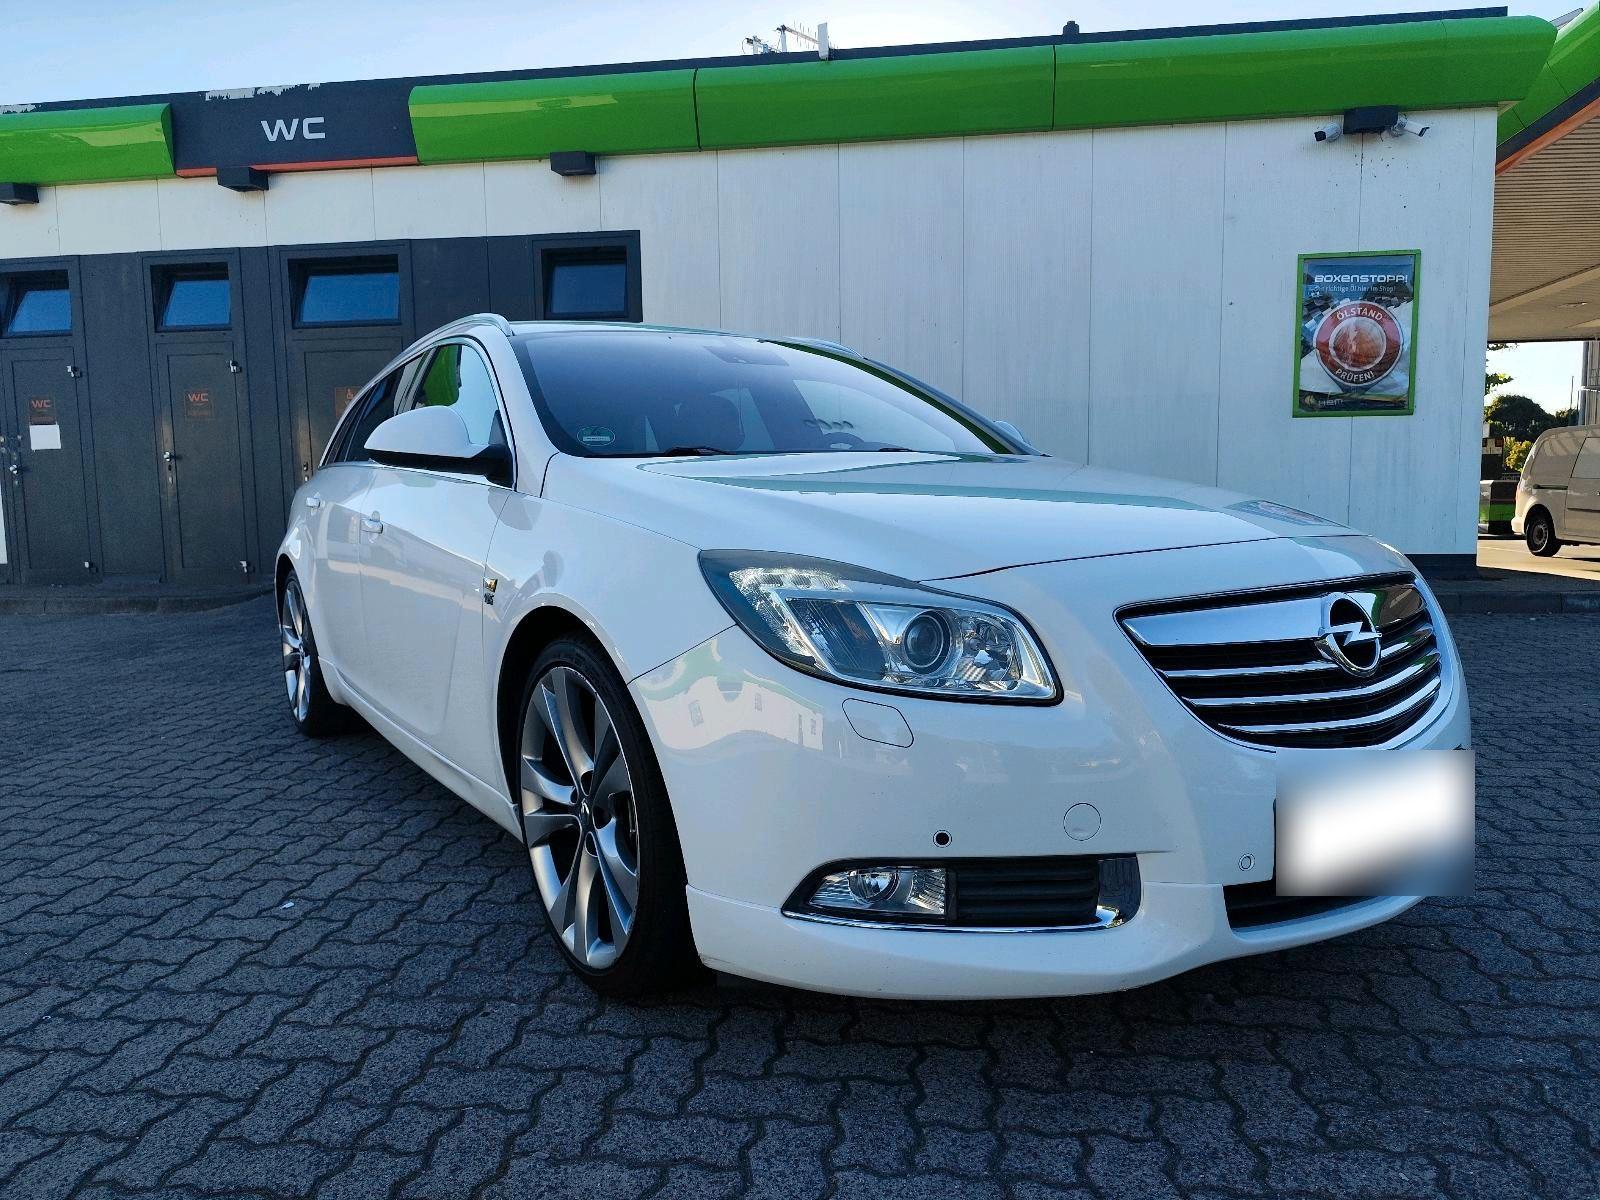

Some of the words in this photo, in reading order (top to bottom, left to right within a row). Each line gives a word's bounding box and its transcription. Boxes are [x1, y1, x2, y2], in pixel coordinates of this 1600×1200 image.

[261, 116, 326, 141] WC
[1336, 307, 1383, 321] ÖLSTAND
[1335, 368, 1375, 382] PRÜFEN!
[31, 399, 51, 408] WC
[188, 393, 209, 401] WC
